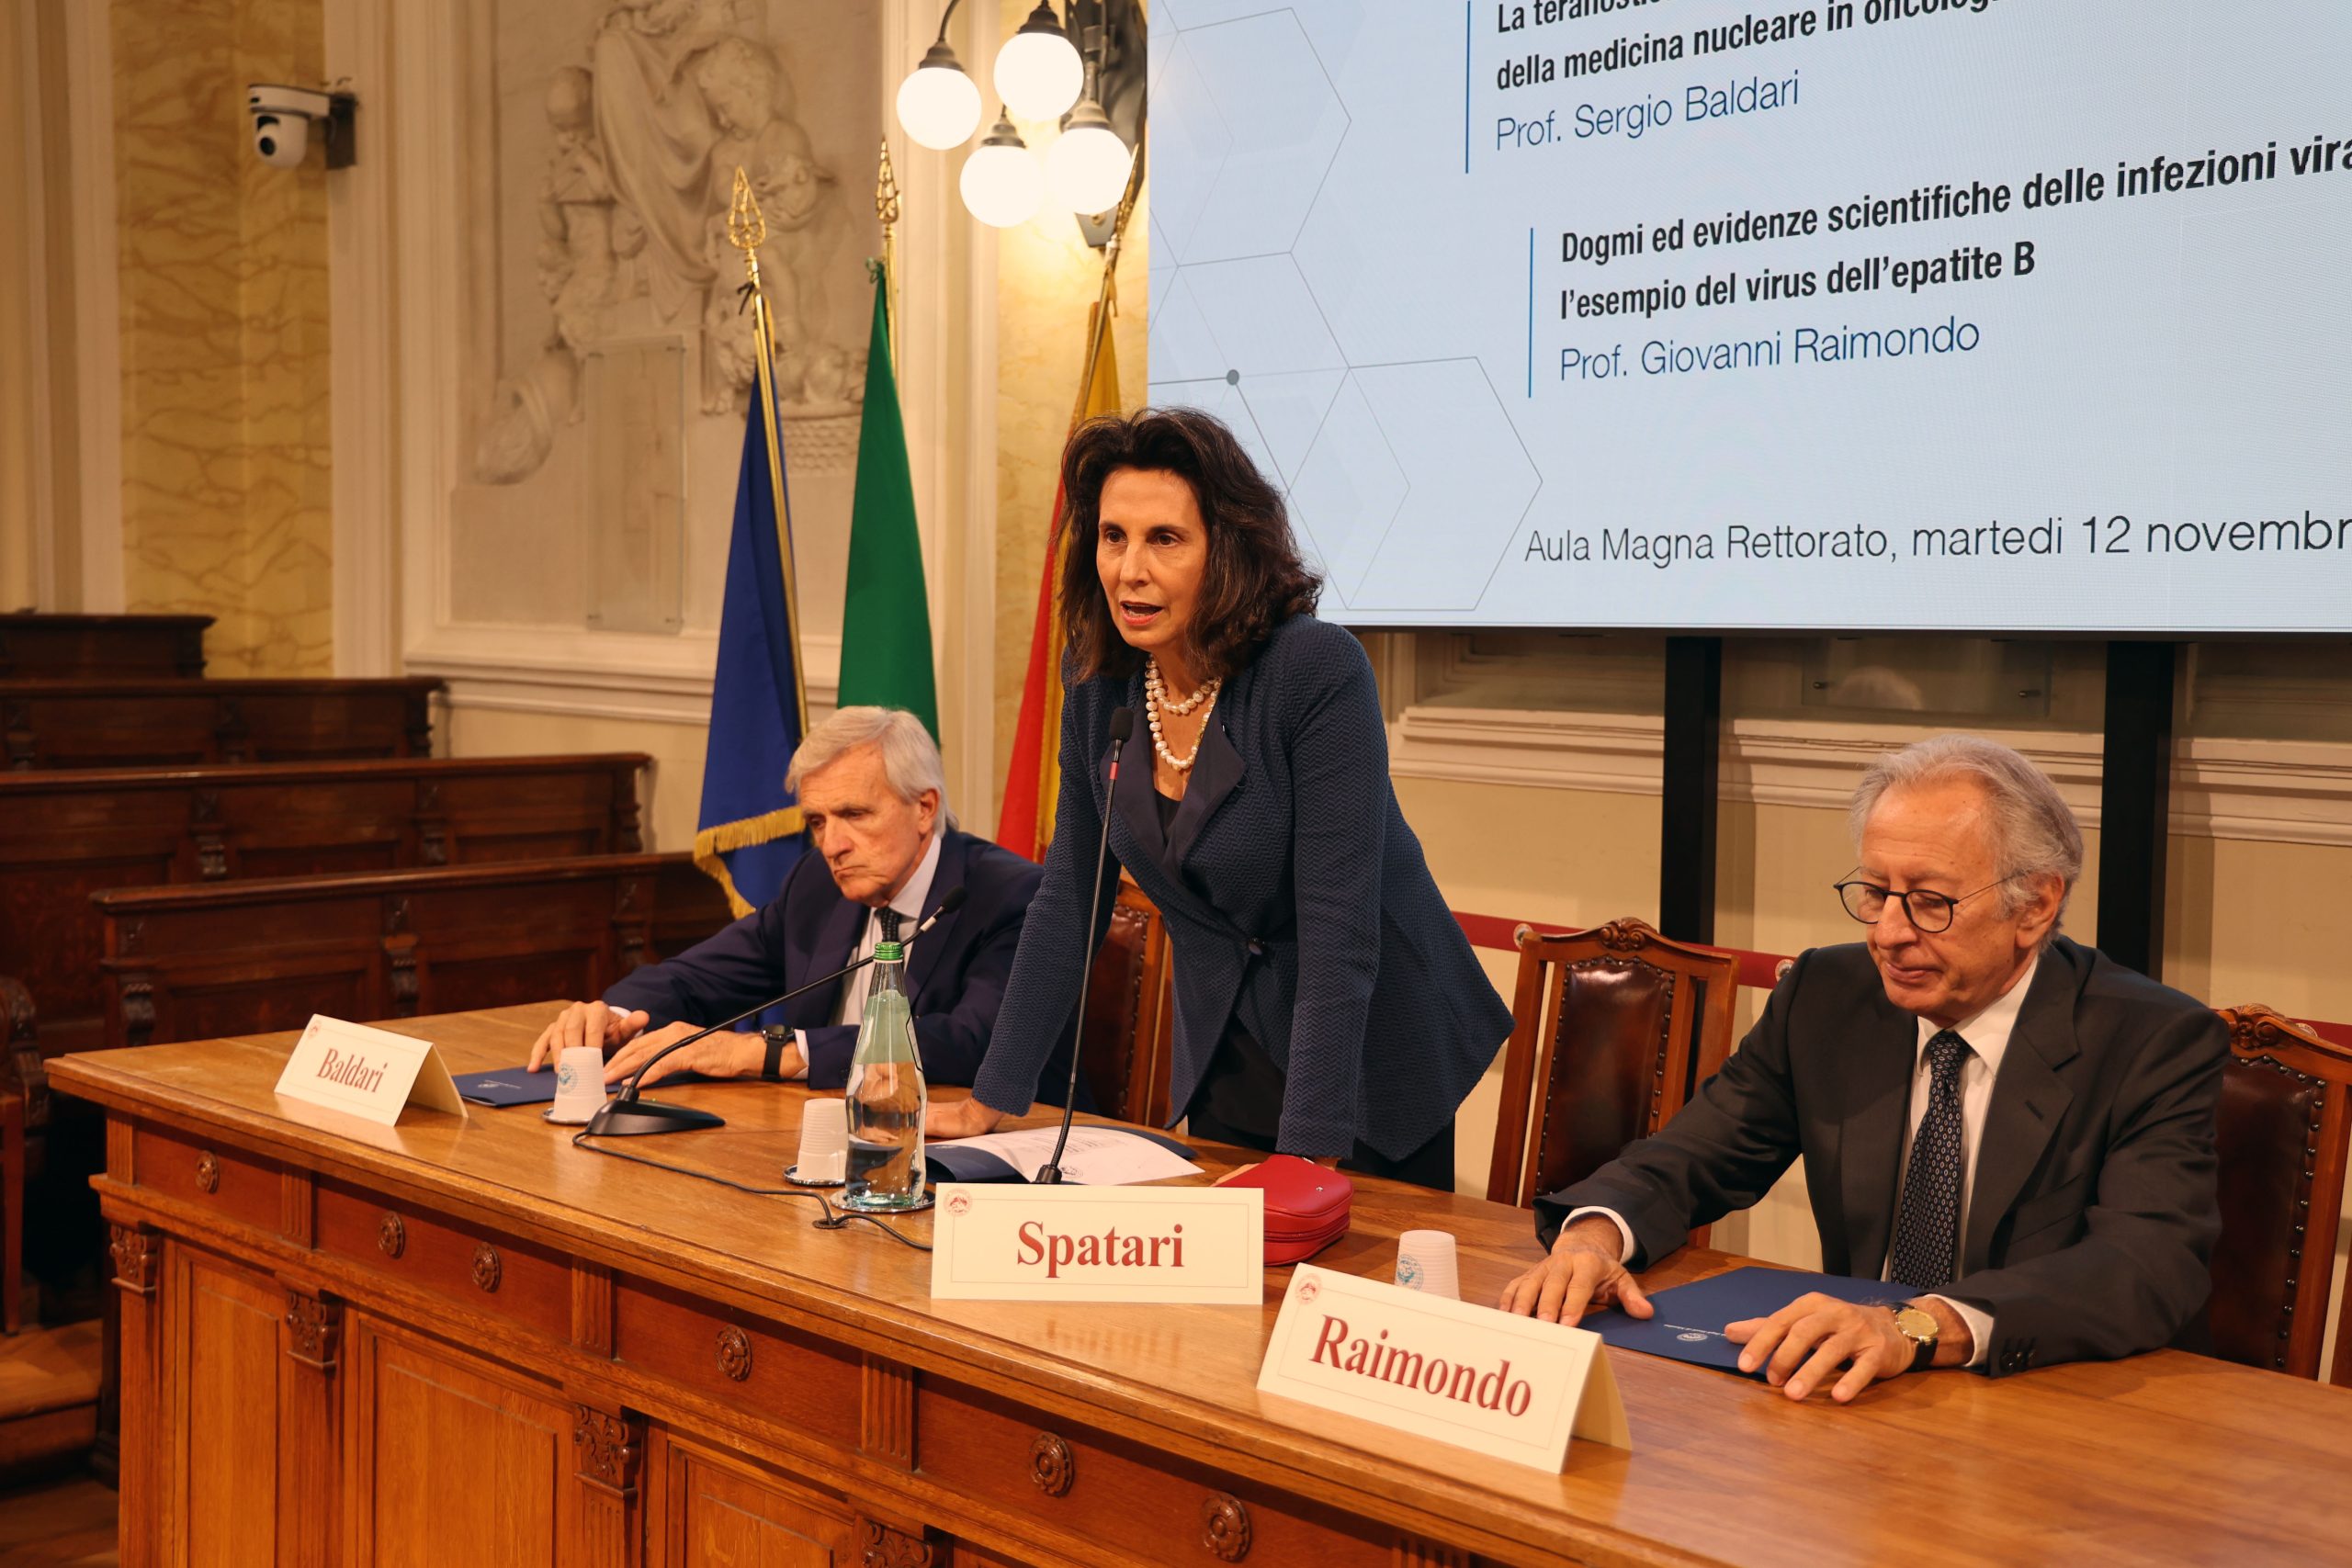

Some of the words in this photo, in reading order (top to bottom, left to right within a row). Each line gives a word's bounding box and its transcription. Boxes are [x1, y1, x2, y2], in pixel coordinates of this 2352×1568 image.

[1497, 53, 1555, 91] della
[1564, 33, 1684, 79] medicina
[1693, 10, 1816, 56] nucleare
[1826, 0, 1853, 32] in
[1498, 3, 1525, 34] La
[1497, 109, 1562, 151] Prof.
[1574, 94, 1672, 140] Sergio
[1686, 69, 1799, 122] Baldari
[1562, 222, 1644, 266] Dogmi
[1652, 218, 1684, 253] ed
[1693, 209, 1818, 248] evidenze
[1827, 180, 2011, 232] scientifiche
[2022, 167, 2105, 209] delle
[2117, 141, 2277, 198] infezioni
[1695, 272, 1736, 307] del
[1746, 268, 1817, 302] virus
[2014, 241, 2035, 276] B
[1561, 344, 1629, 381] Prof.
[1641, 331, 1781, 375] Giovanni
[1794, 315, 1980, 364] Raimondo
[1524, 529, 1591, 562] Aula
[1602, 527, 1714, 570] Magna
[1727, 523, 1896, 564] Rettorato,
[1913, 517, 2063, 557] martedi
[2082, 514, 2131, 554] 12
[317, 1047, 389, 1094] Baldari
[1016, 1220, 1185, 1280] Spatari
[1308, 1314, 1532, 1418] Raimondo
